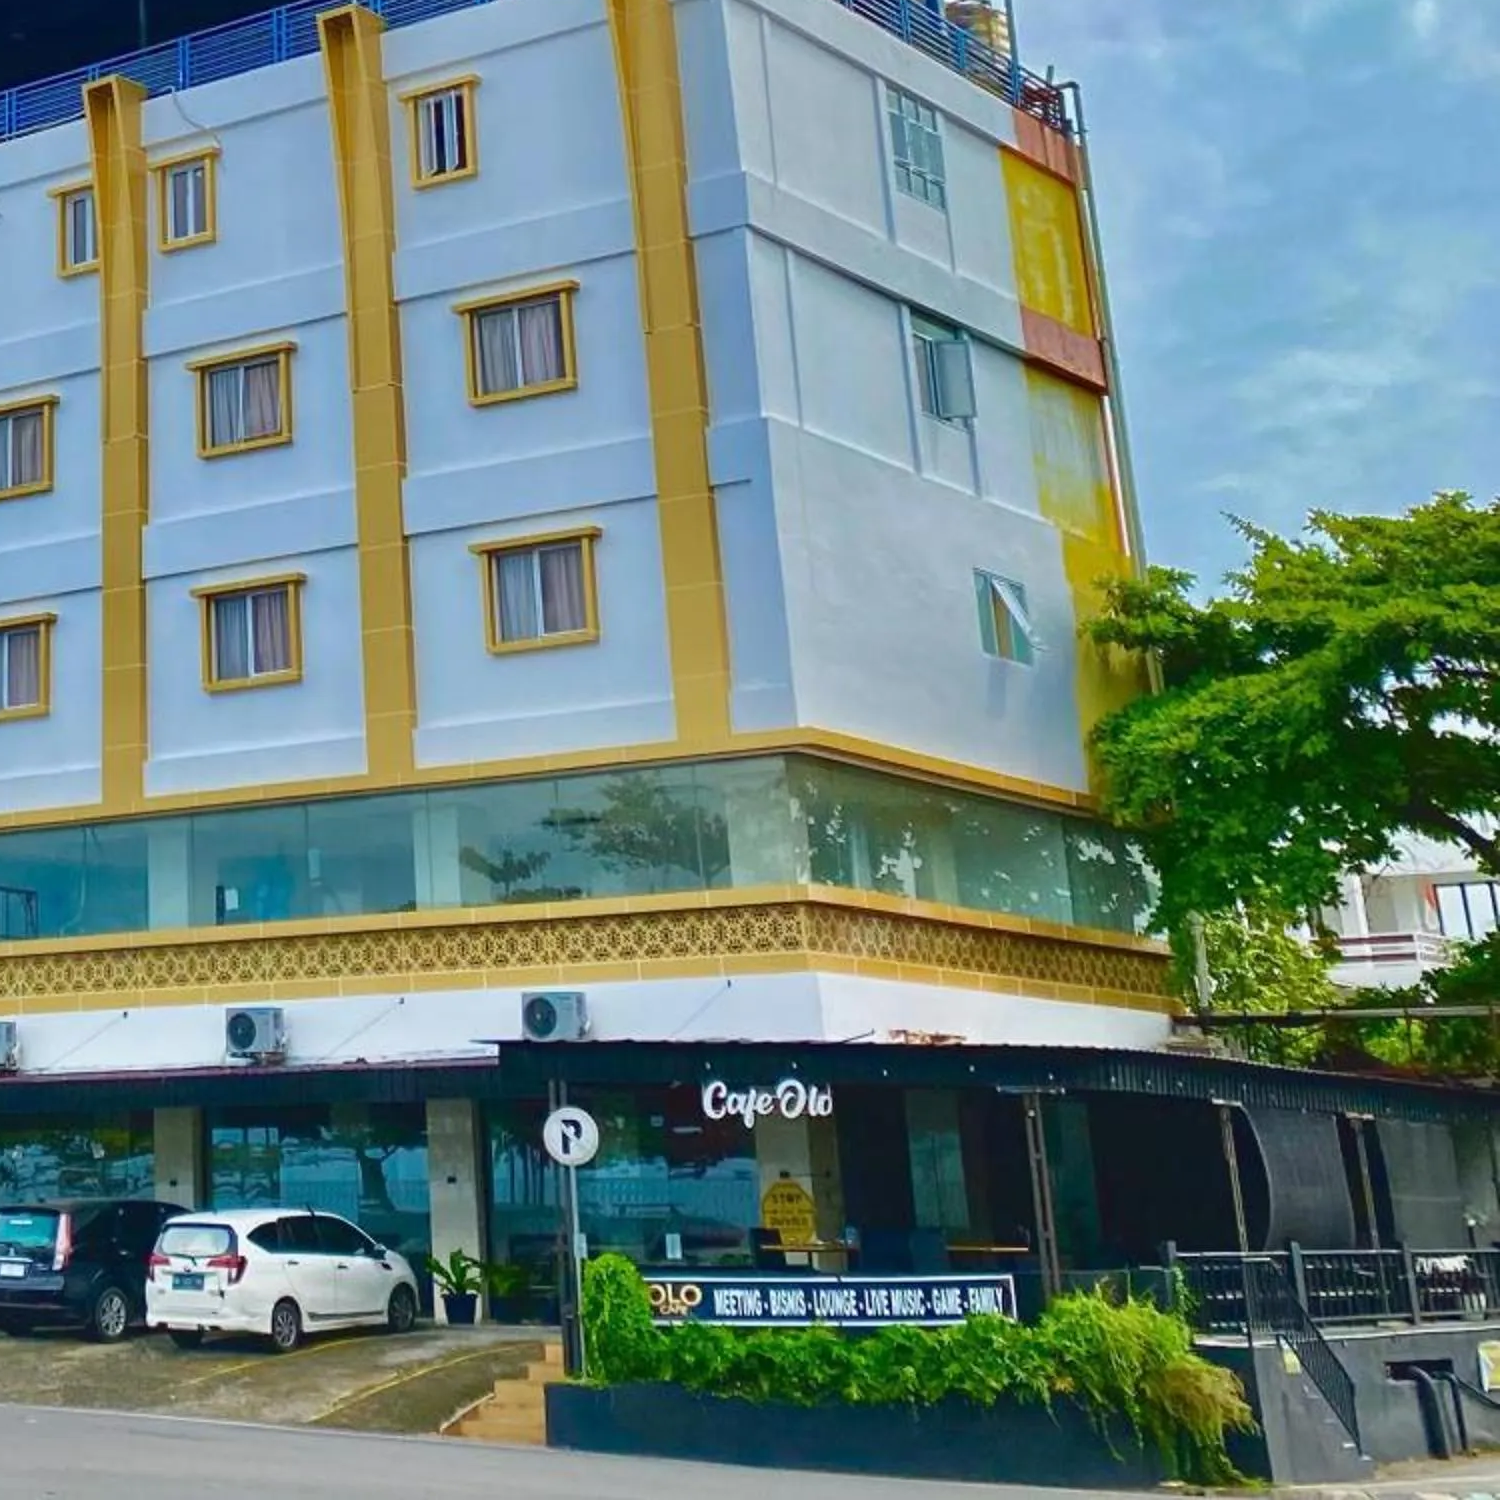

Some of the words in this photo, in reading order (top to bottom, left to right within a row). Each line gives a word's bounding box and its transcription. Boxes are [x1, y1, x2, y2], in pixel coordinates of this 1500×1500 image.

[702, 1080, 775, 1129] Cafe
[561, 1119, 583, 1155] P
[648, 1283, 703, 1307] OLO
[713, 1288, 763, 1317] MEETING
[812, 1288, 859, 1317] LOUNGE
[863, 1288, 891, 1317] LIVE
[891, 1287, 926, 1317] MUSIC
[931, 1287, 963, 1316] GAME
[967, 1286, 1003, 1315] FAMILY
